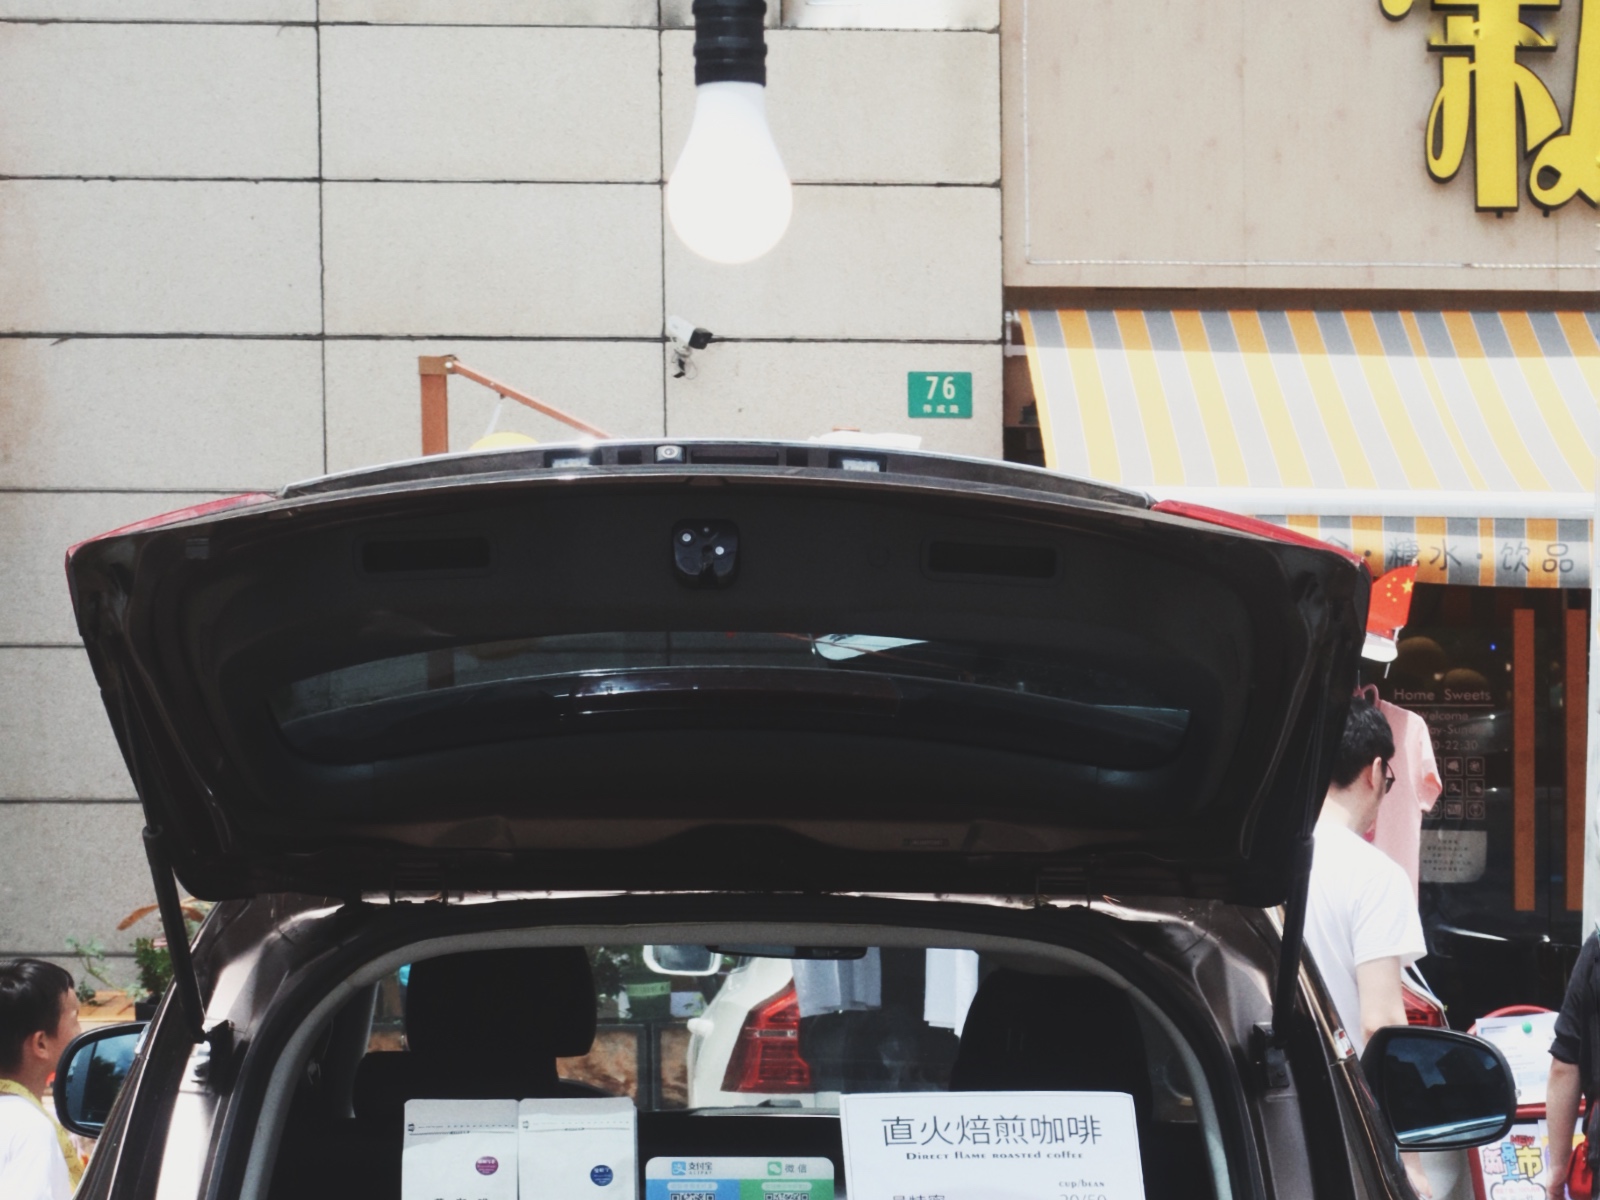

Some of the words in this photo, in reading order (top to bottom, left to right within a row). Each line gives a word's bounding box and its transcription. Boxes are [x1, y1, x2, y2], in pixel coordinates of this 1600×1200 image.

[926, 376, 955, 400] 76
[1394, 688, 1435, 700] Home
[1444, 689, 1492, 700] Sweets
[1417, 711, 1469, 720] Welcome
[881, 1115, 1103, 1147] 直火焙煎咖啡
[1510, 1135, 1535, 1146] NEW
[688, 1161, 712, 1171] 支付宝
[785, 1164, 807, 1173] 微信
